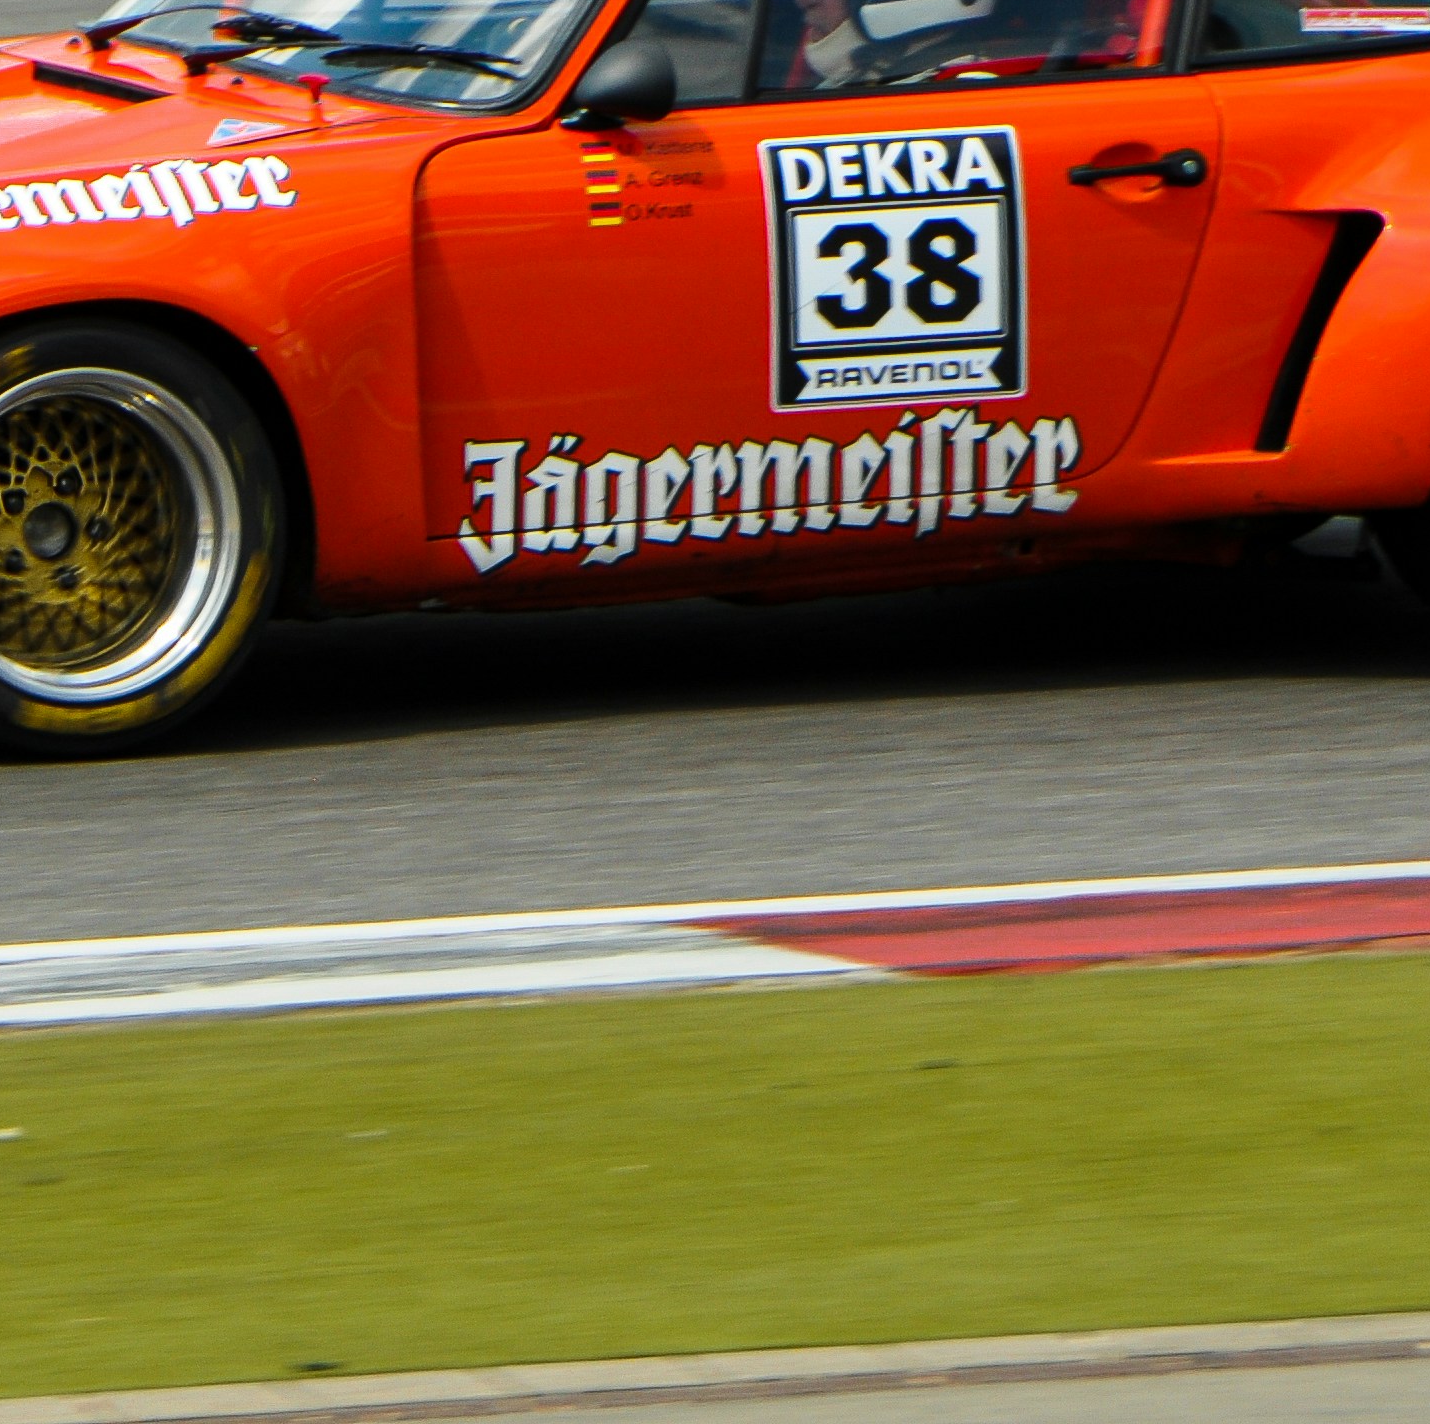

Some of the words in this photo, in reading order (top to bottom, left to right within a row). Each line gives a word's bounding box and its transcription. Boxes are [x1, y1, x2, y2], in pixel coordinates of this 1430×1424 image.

[777, 136, 1007, 202] DEKRA
[815, 216, 982, 330] 38
[815, 359, 985, 389] RAVENOL
[458, 407, 1080, 574] Jägermeister
